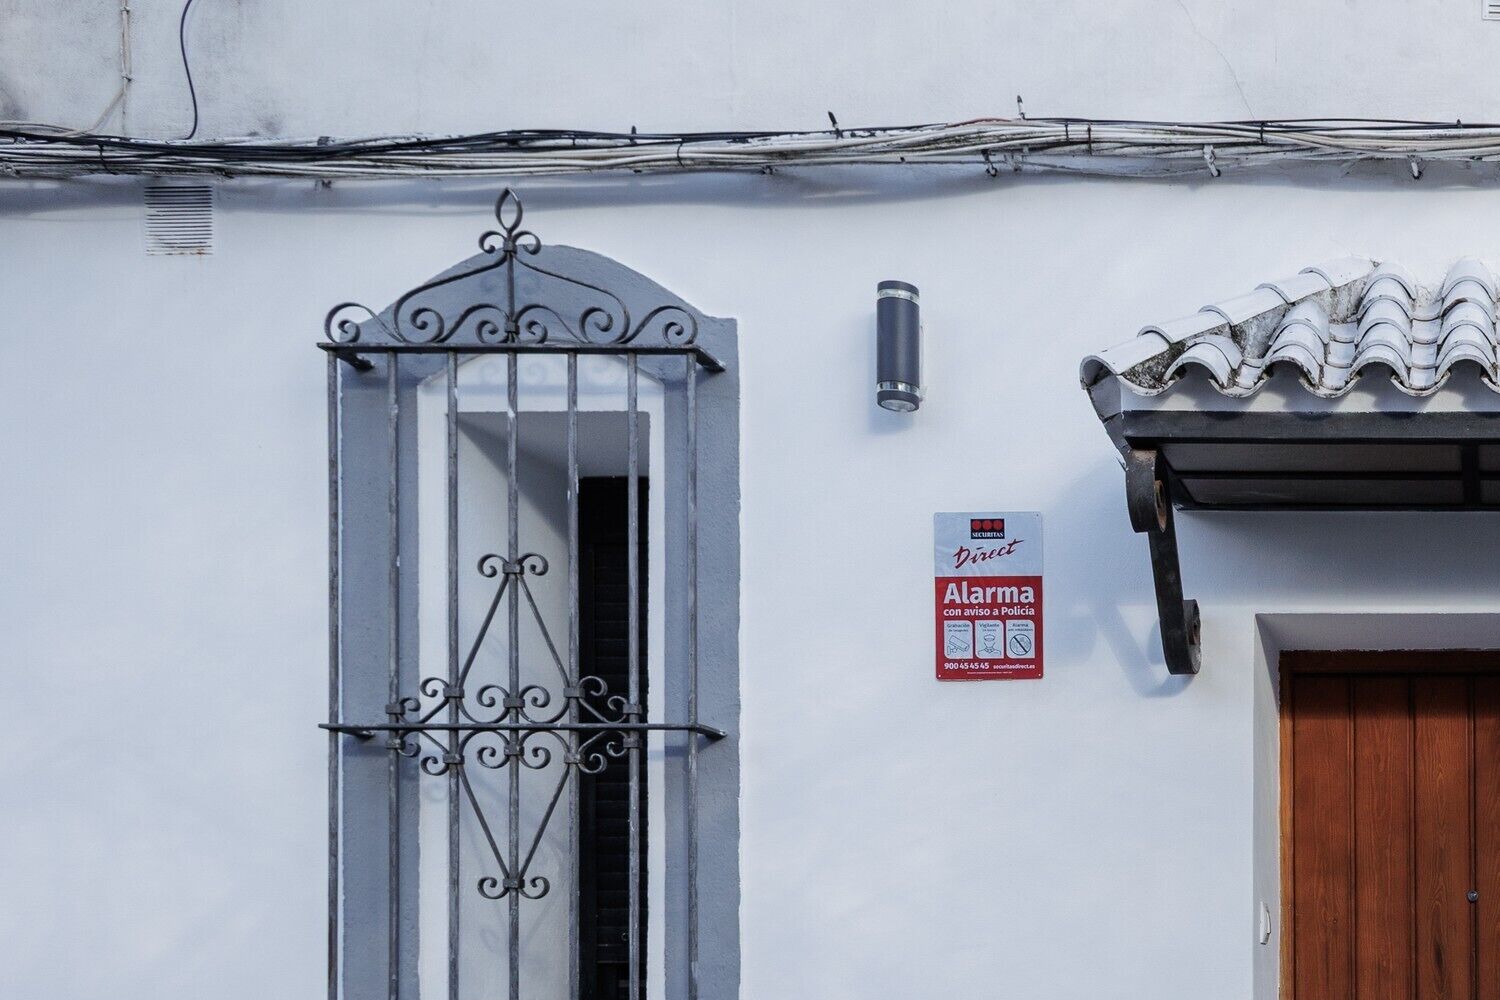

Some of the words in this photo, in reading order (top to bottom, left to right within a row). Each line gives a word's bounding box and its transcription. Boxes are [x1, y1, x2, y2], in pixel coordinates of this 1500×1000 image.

[953, 539, 1024, 569] Direct
[943, 581, 1035, 604] Alarma
[943, 608, 961, 616] con
[964, 606, 990, 616] aviso
[1001, 606, 1035, 616] Policía
[944, 662, 959, 670] 900
[959, 662, 969, 670] 45
[969, 662, 979, 670] 45
[980, 662, 990, 670] 45
